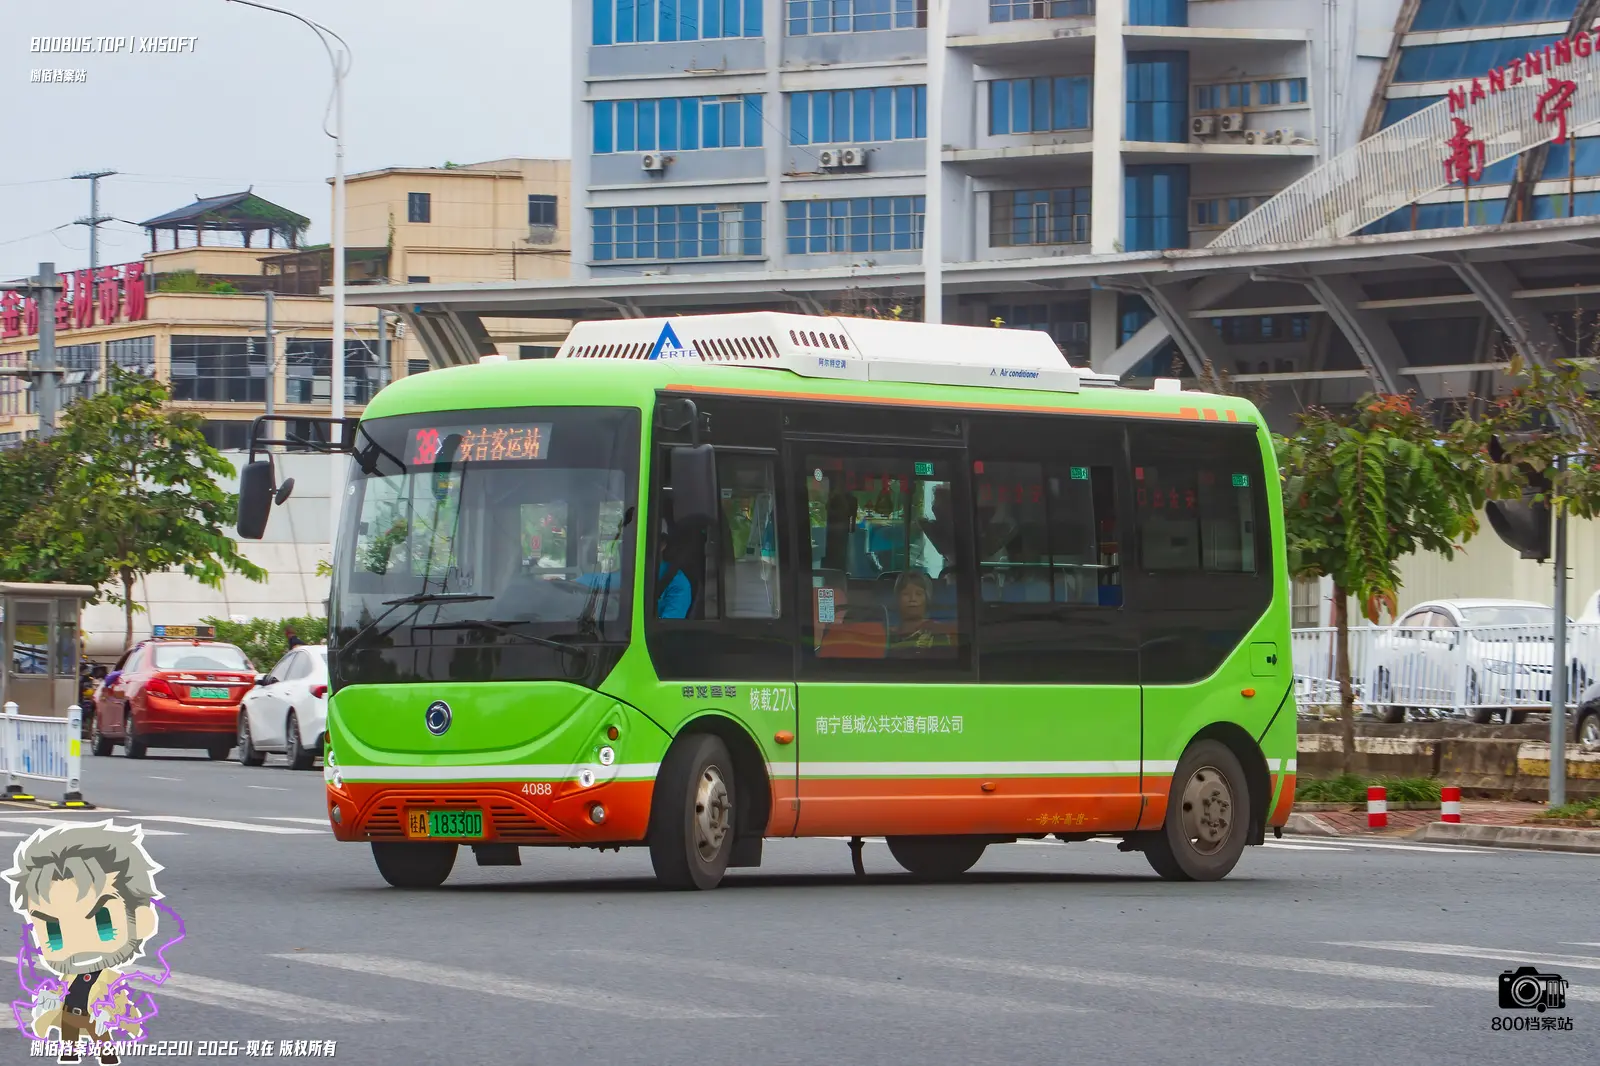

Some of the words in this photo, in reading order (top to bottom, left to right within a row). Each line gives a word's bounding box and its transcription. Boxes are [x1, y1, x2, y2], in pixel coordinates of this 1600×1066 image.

[1000, 368, 1008, 377] Air
[1008, 369, 1039, 378] conditioner
[413, 428, 439, 465] 38
[460, 427, 541, 462] 安吉客运站
[816, 715, 963, 734] 南宁邕城公共交通有限公司
[521, 783, 552, 795] 4088
